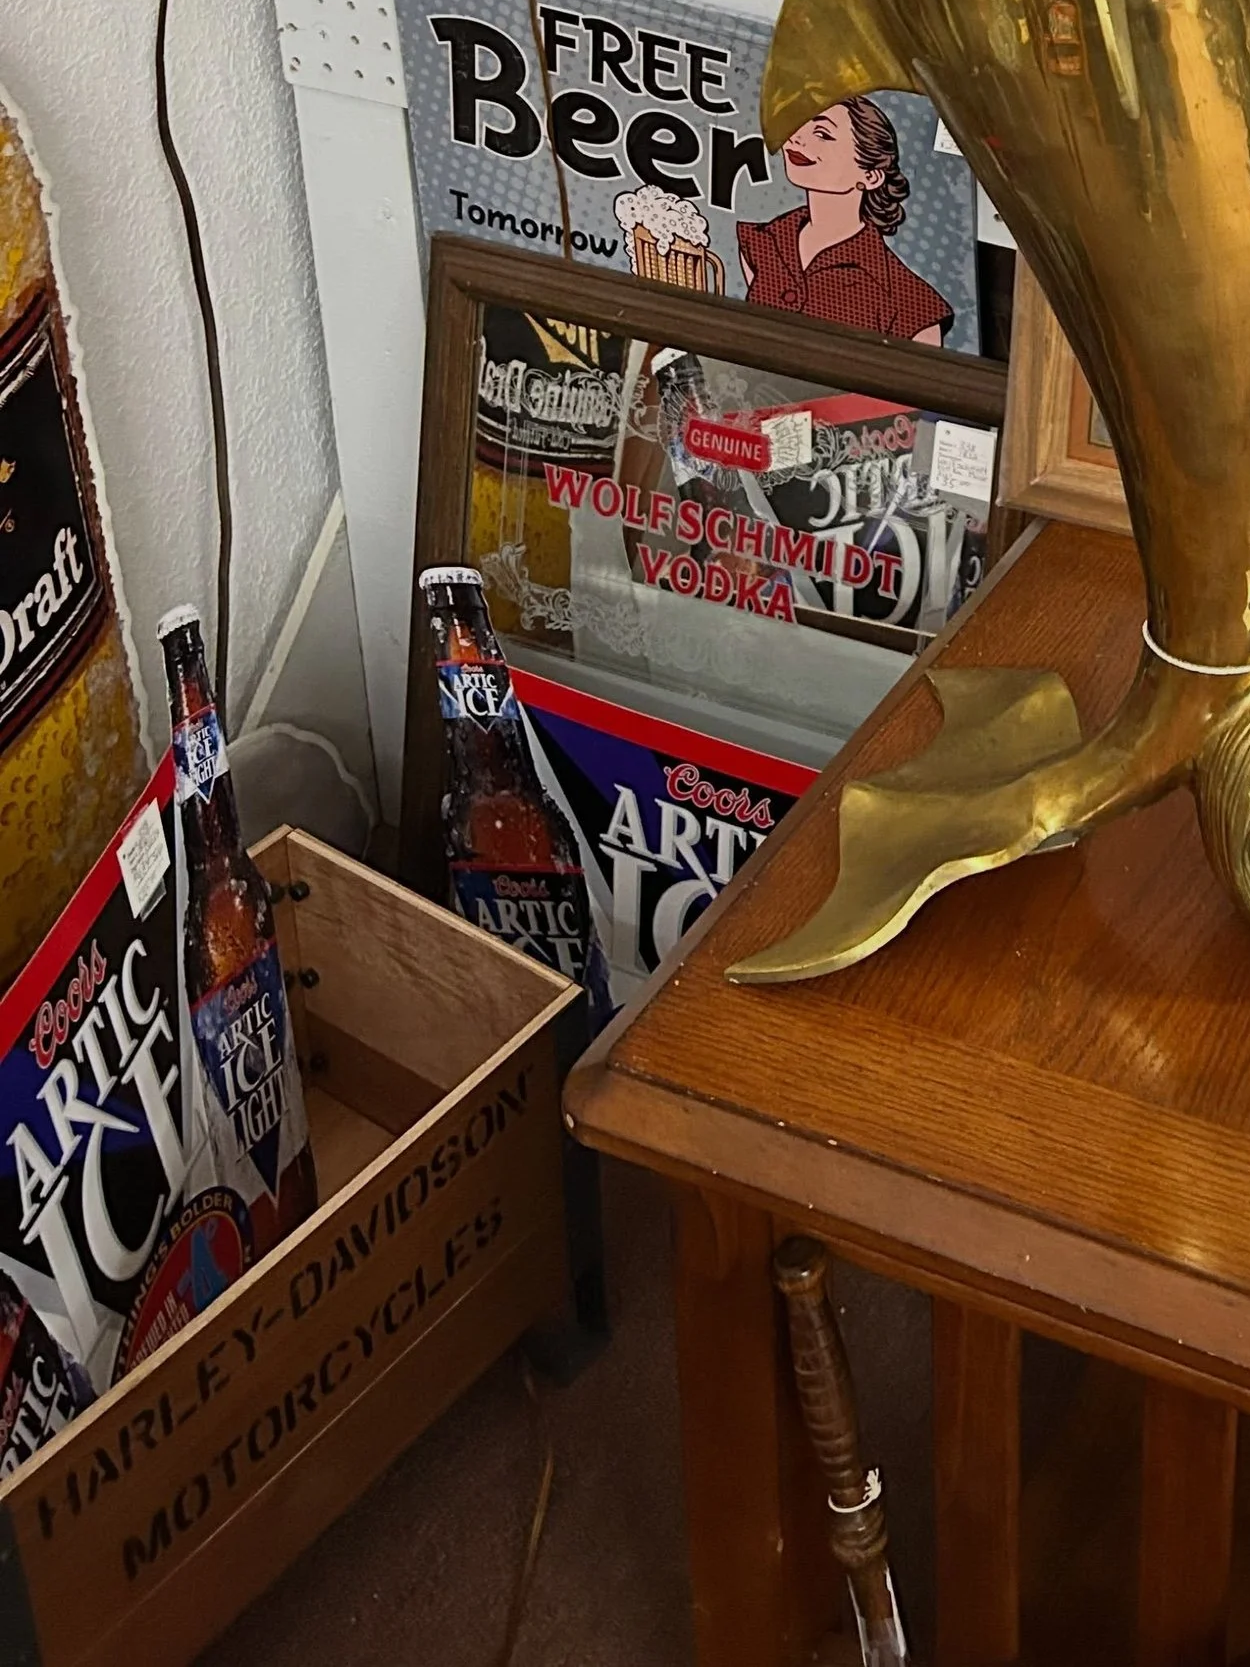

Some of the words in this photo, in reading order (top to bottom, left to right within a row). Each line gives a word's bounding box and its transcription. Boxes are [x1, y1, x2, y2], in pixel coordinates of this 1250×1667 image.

[539, 4, 736, 115] FREE
[427, 14, 770, 211] Beer
[448, 188, 619, 259] Tomorrow
[690, 428, 763, 463] GENUINE
[543, 462, 903, 601] WOLFSCHMIDT
[453, 673, 498, 691] ARTIC
[457, 687, 502, 717] ICE
[663, 762, 775, 830] Coors
[475, 897, 578, 944] ARTIC
[492, 875, 551, 898] Coors
[29, 937, 107, 1070] Coors
[218, 992, 274, 1061] ARTIC
[6, 938, 161, 1231] ARTIC
[219, 1017, 282, 1112] ICE
[230, 1065, 289, 1164] LIGHT
[23, 1009, 198, 1359] ICE
[170, 1192, 233, 1241] BOLDER
[36, 1066, 534, 1540] HARLEY-DAVIDSON
[120, 1199, 507, 1581] MOTORCYCLES
